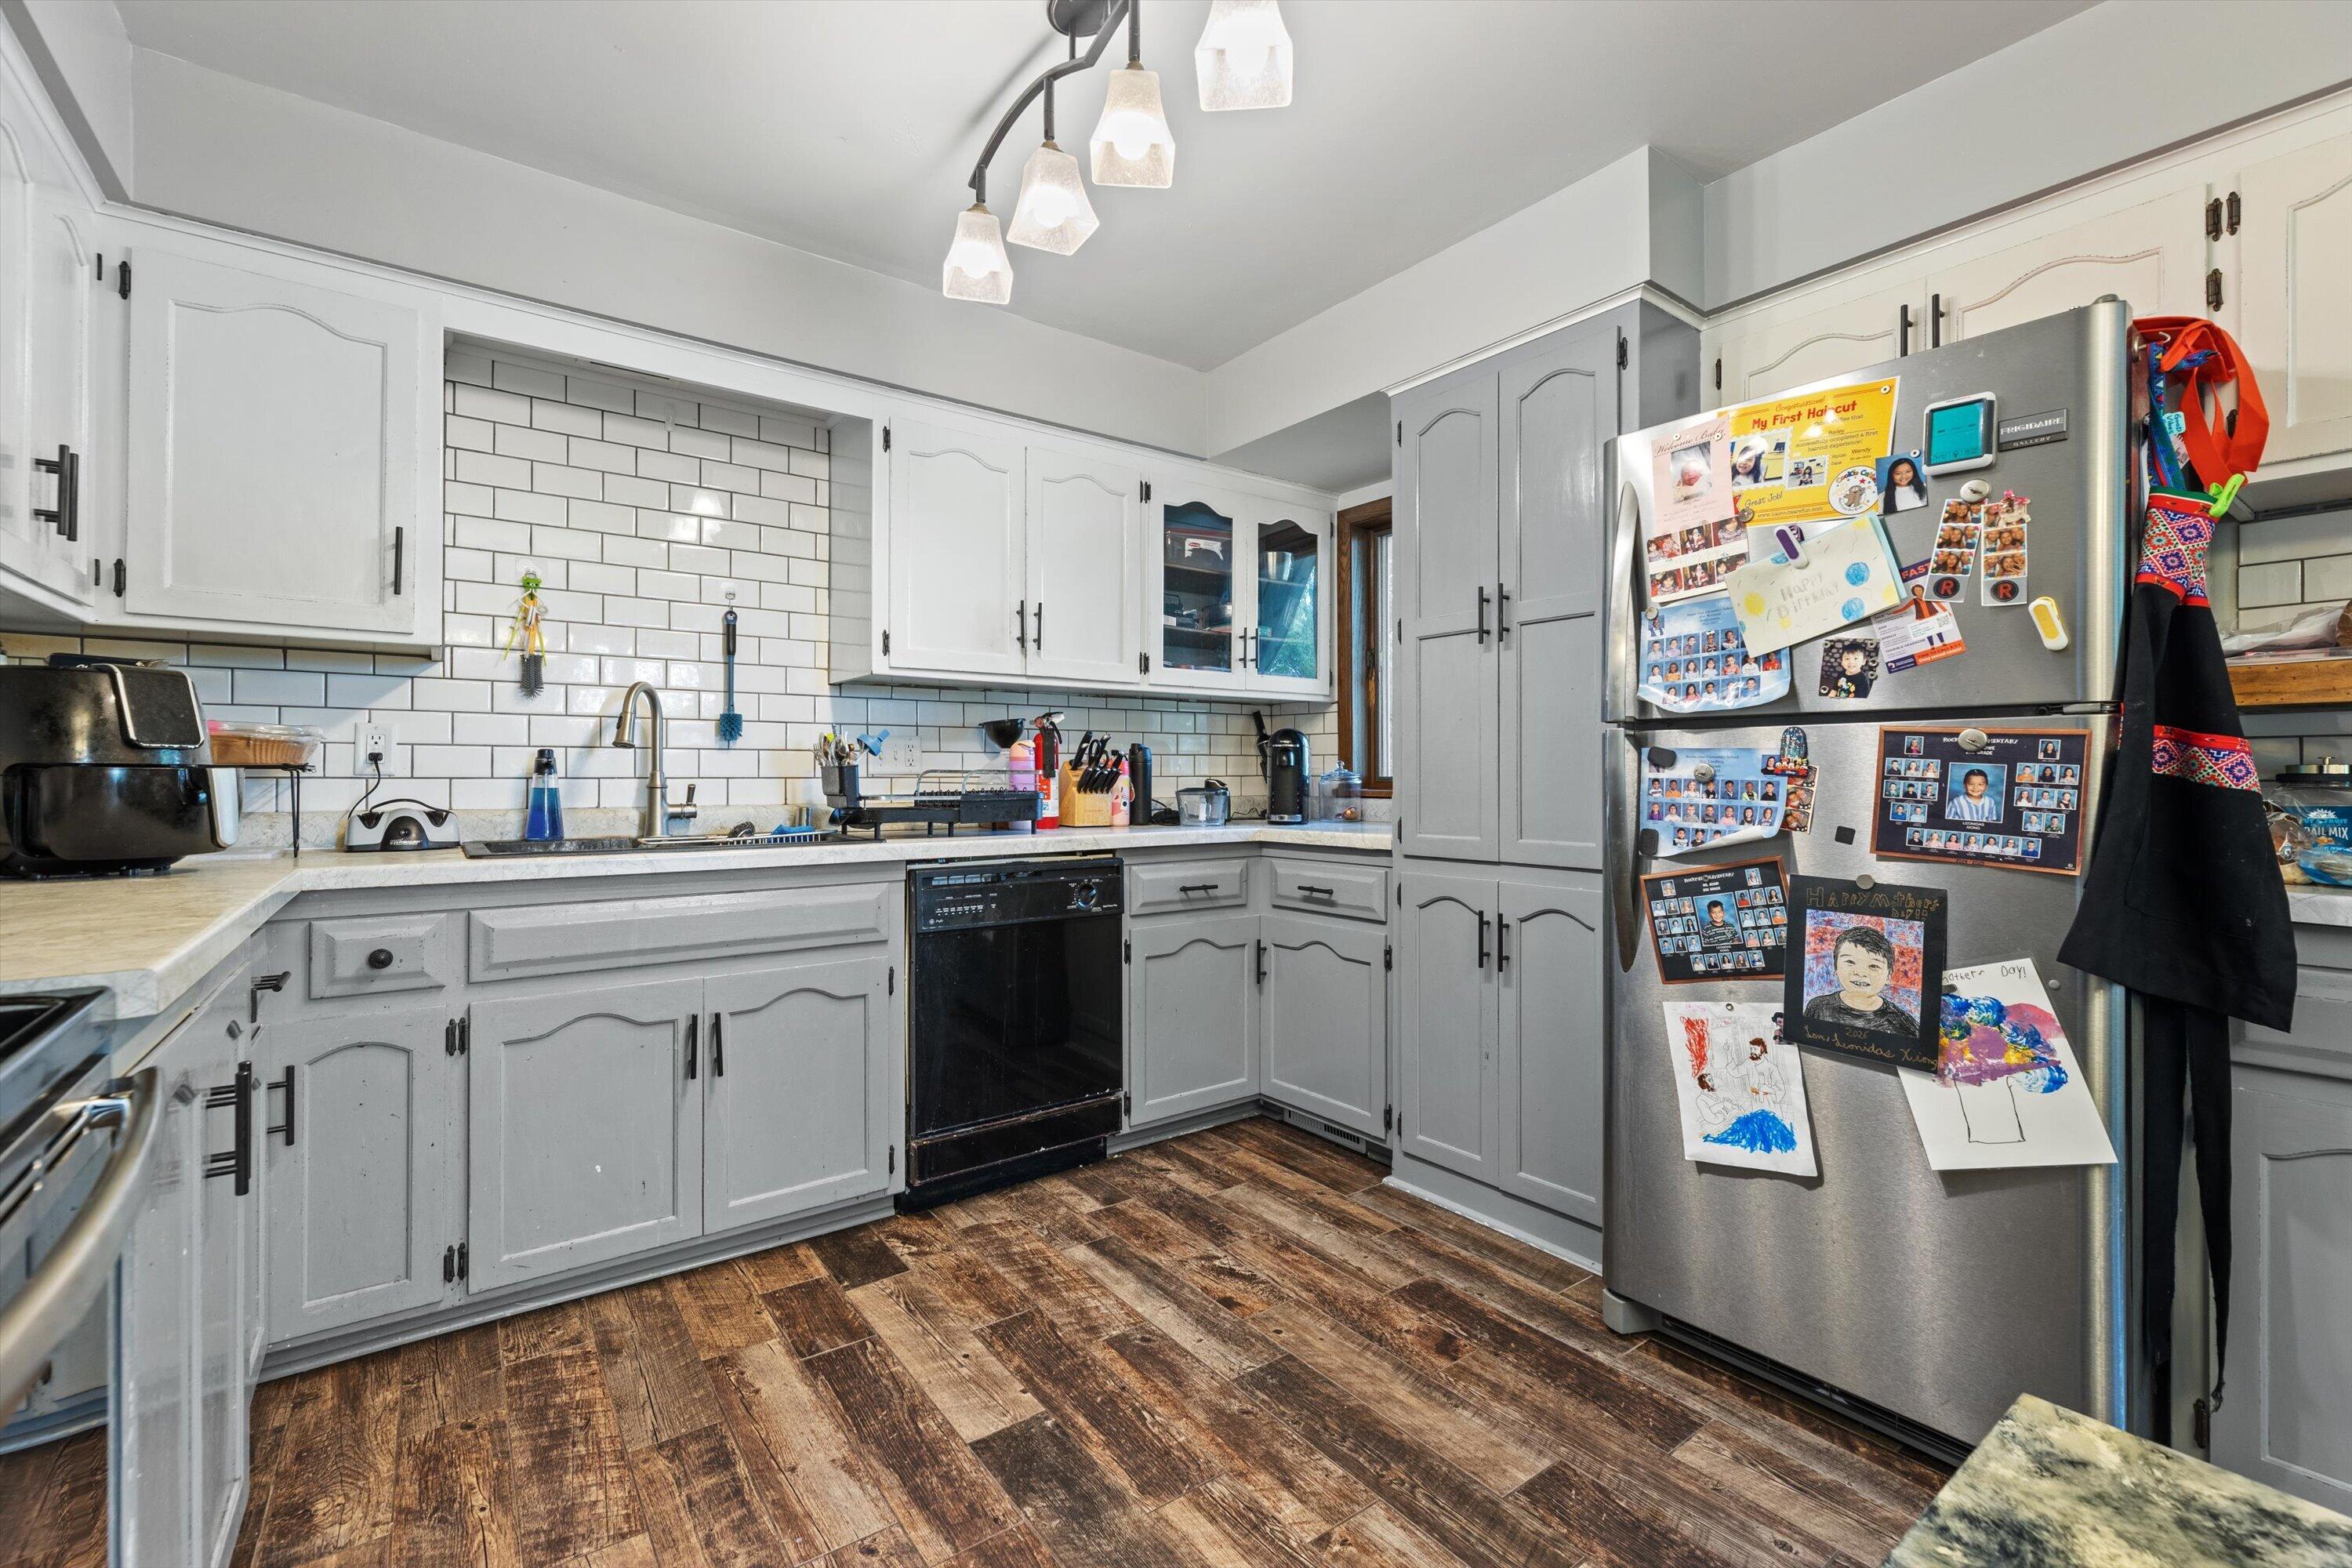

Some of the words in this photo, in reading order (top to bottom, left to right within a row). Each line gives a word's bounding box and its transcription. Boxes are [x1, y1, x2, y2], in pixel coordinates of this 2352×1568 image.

[1776, 396, 1825, 412] Congratulations!
[1752, 418, 1767, 430] My
[1773, 411, 1802, 426] First
[2001, 417, 2063, 434] FRIGIDAIRE
[1655, 437, 1693, 455] Welcome
[2013, 436, 2051, 447] GALLERY
[1744, 496, 1766, 509] Great
[1768, 492, 1783, 503] Job!
[1902, 561, 1931, 579] FAST
[1940, 579, 1955, 595] R
[1998, 583, 2012, 599] R
[2304, 827, 2327, 836] RAIL
[2328, 827, 2349, 840] MIX
[1832, 1033, 1896, 1058] Leonidas
[1900, 1048, 1938, 1071] Xiong
